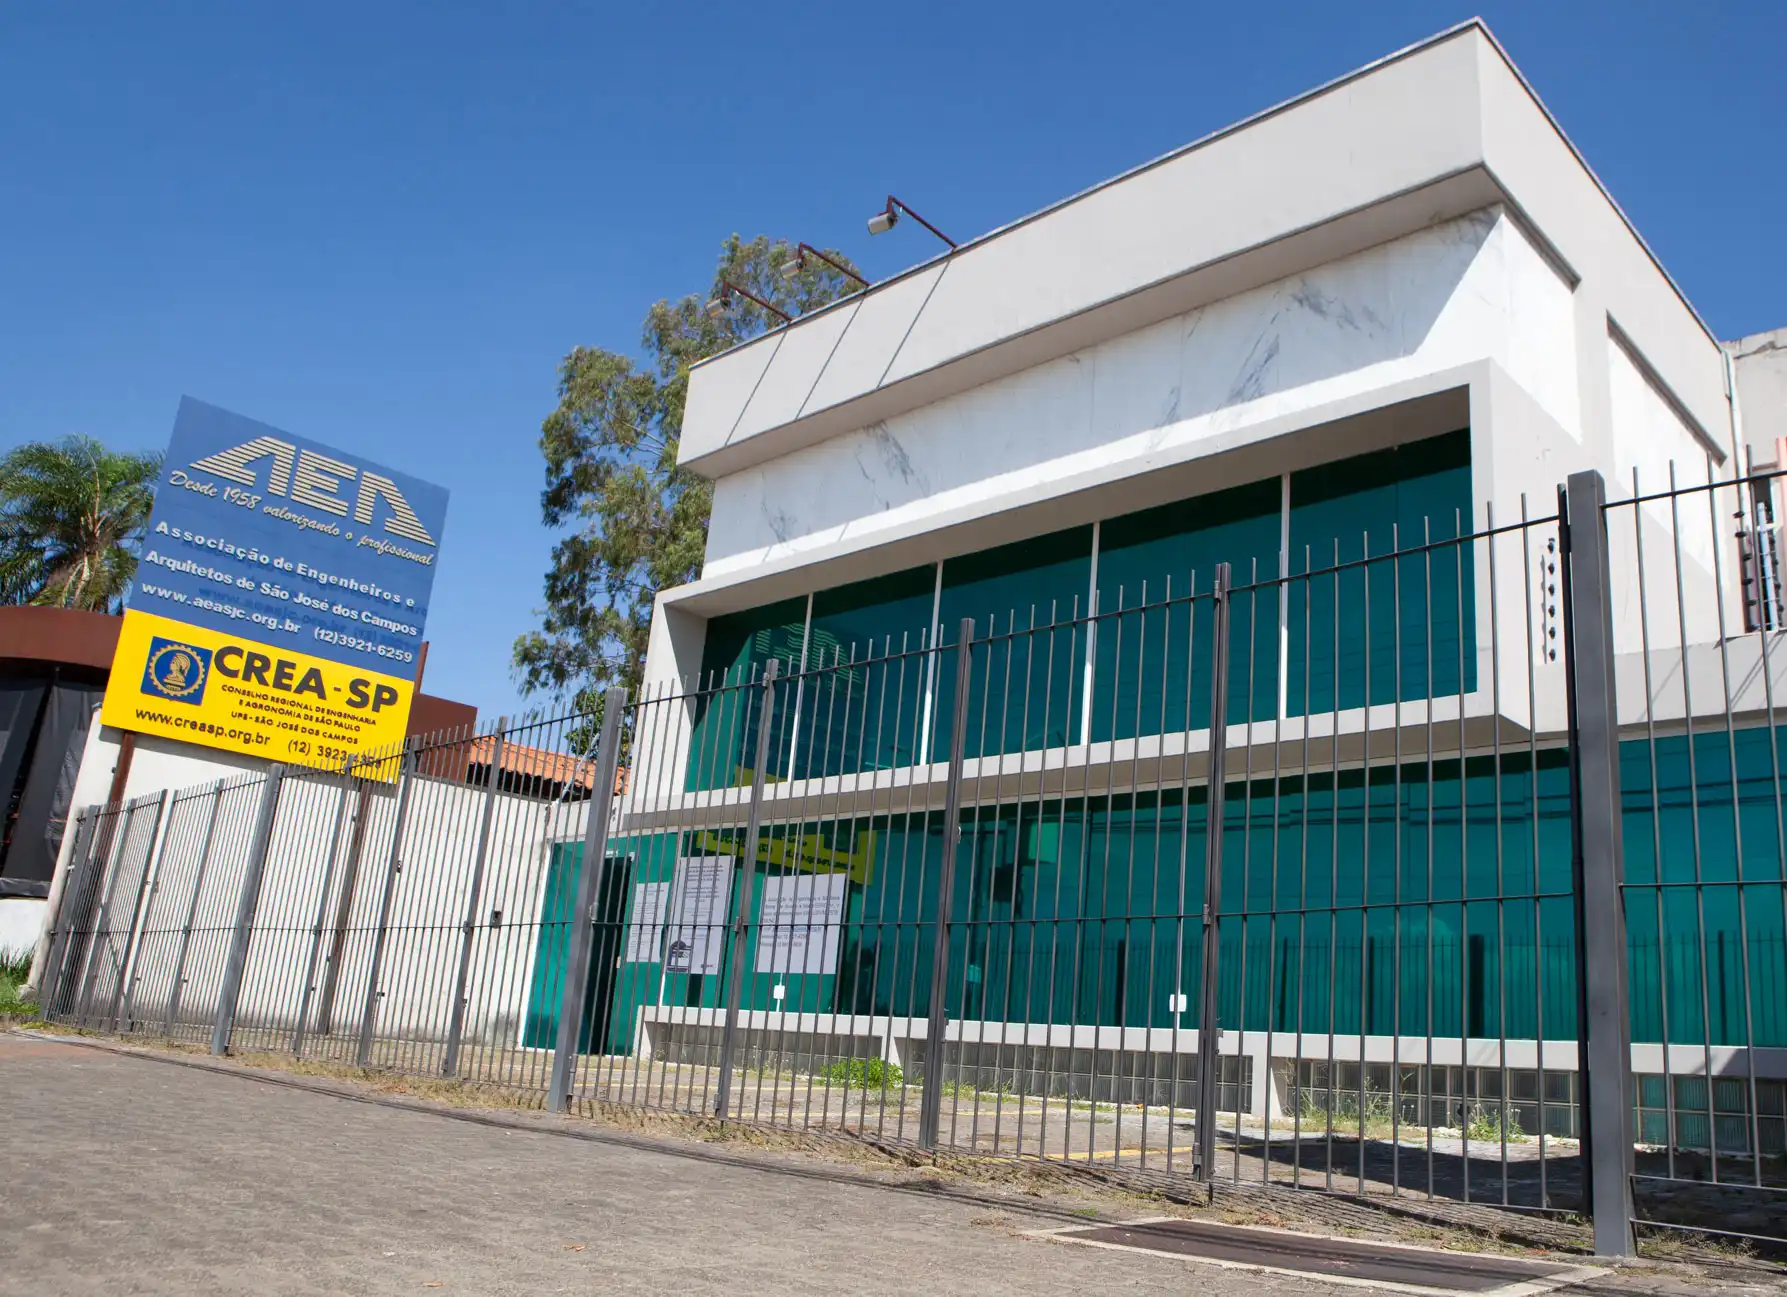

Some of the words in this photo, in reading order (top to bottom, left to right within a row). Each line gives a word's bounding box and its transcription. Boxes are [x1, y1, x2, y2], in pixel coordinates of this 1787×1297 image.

[188, 436, 436, 547] AEA
[169, 470, 218, 497] Desde
[223, 486, 262, 509] 1958
[263, 505, 340, 536] valorizando
[345, 532, 353, 540] o
[356, 535, 434, 565] profissional
[155, 521, 270, 565] Associação
[273, 557, 293, 571] de
[296, 563, 401, 603] Engenheiros
[405, 598, 415, 607] e
[142, 583, 301, 633] www.aeasjc.org.br
[145, 550, 233, 585] Arquitetos
[236, 577, 255, 591] de
[260, 582, 290, 600] São
[293, 592, 329, 611] José
[332, 604, 359, 620] dos
[361, 611, 418, 636] Campos
[221, 684, 269, 701] CONSELHO
[270, 696, 313, 712] REGIONAL
[315, 706, 325, 715] DE
[326, 708, 376, 725] ENGENHARIA
[244, 700, 302, 719] AGRONOMIA
[303, 713, 314, 722] DE
[315, 714, 332, 726] SÃO
[333, 720, 361, 732] PAULO
[254, 714, 274, 726] SÃO
[276, 721, 298, 732] JOSÉ
[301, 727, 320, 737] DOS
[322, 731, 359, 745] CAMPOS
[135, 709, 271, 745] www.creasp.org.br
[288, 739, 311, 757] (12)
